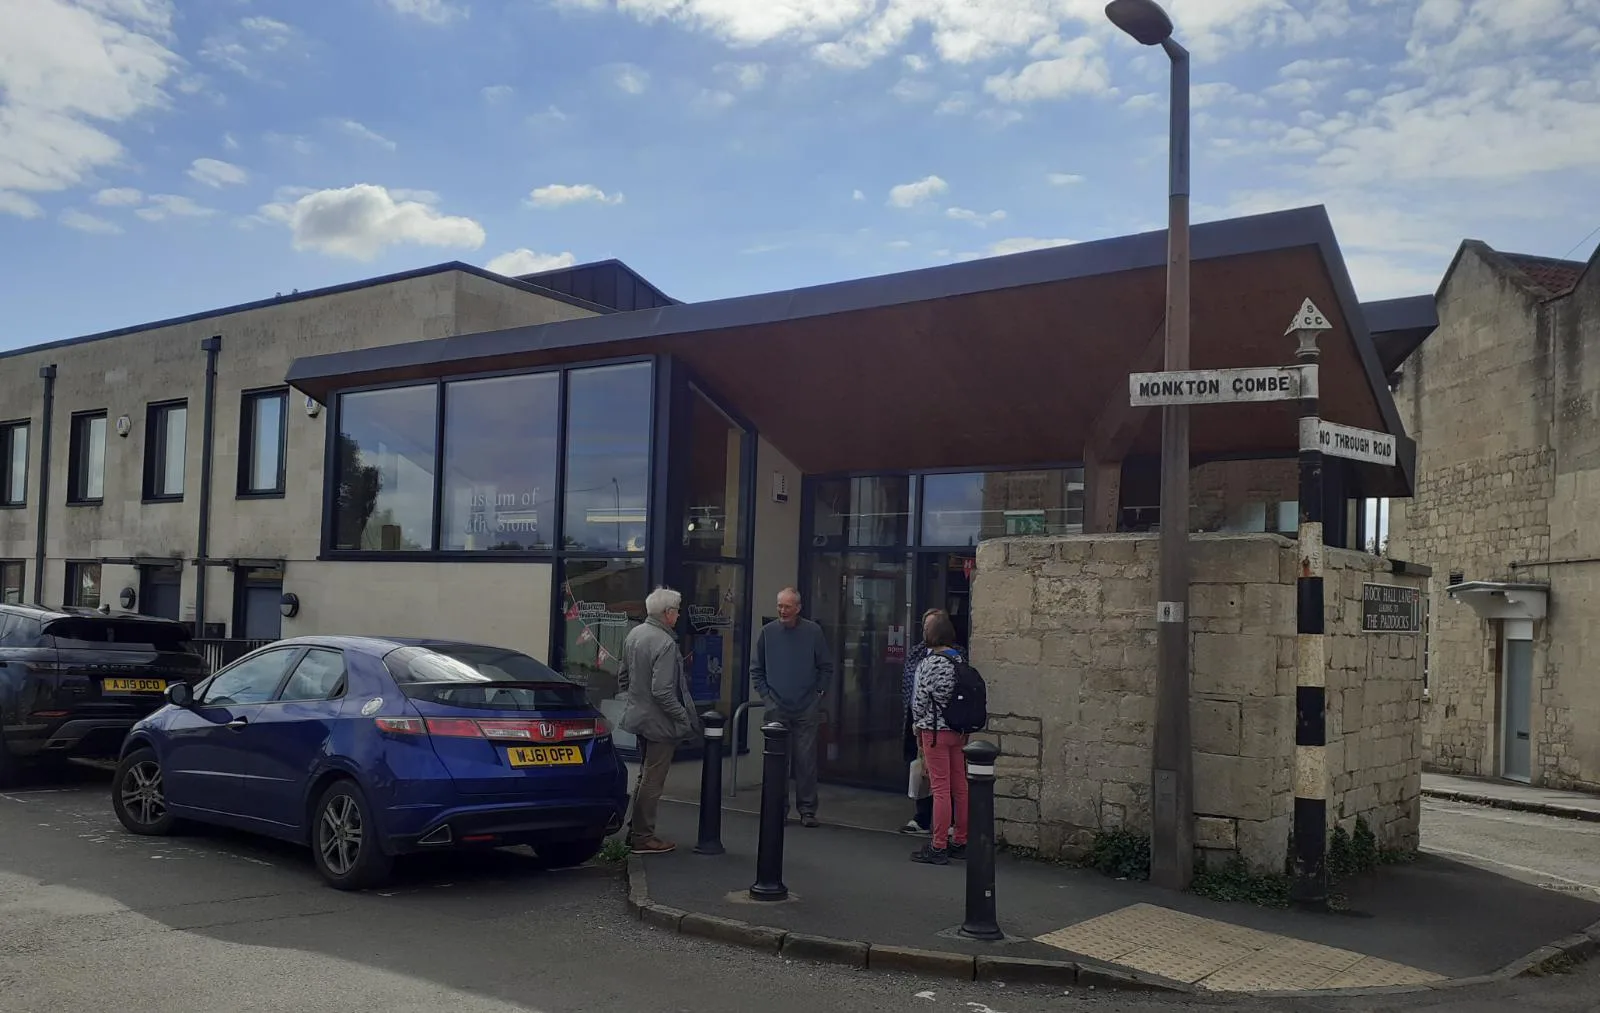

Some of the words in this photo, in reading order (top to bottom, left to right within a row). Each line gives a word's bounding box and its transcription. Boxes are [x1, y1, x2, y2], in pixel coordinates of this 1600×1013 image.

[1306, 304, 1314, 314] S
[1139, 379, 1219, 397] MONKTON
[1232, 376, 1290, 393] COMBE
[1319, 430, 1330, 446] NO
[1335, 433, 1370, 454] THROUGH
[1374, 441, 1391, 457] ROAD
[1364, 586, 1381, 601] ROCK
[1382, 588, 1397, 603] HALL
[1398, 589, 1412, 604] LANE
[1366, 614, 1378, 629] THE
[1380, 614, 1410, 629] PADDOCKS
[549, 747, 574, 761] OFP
